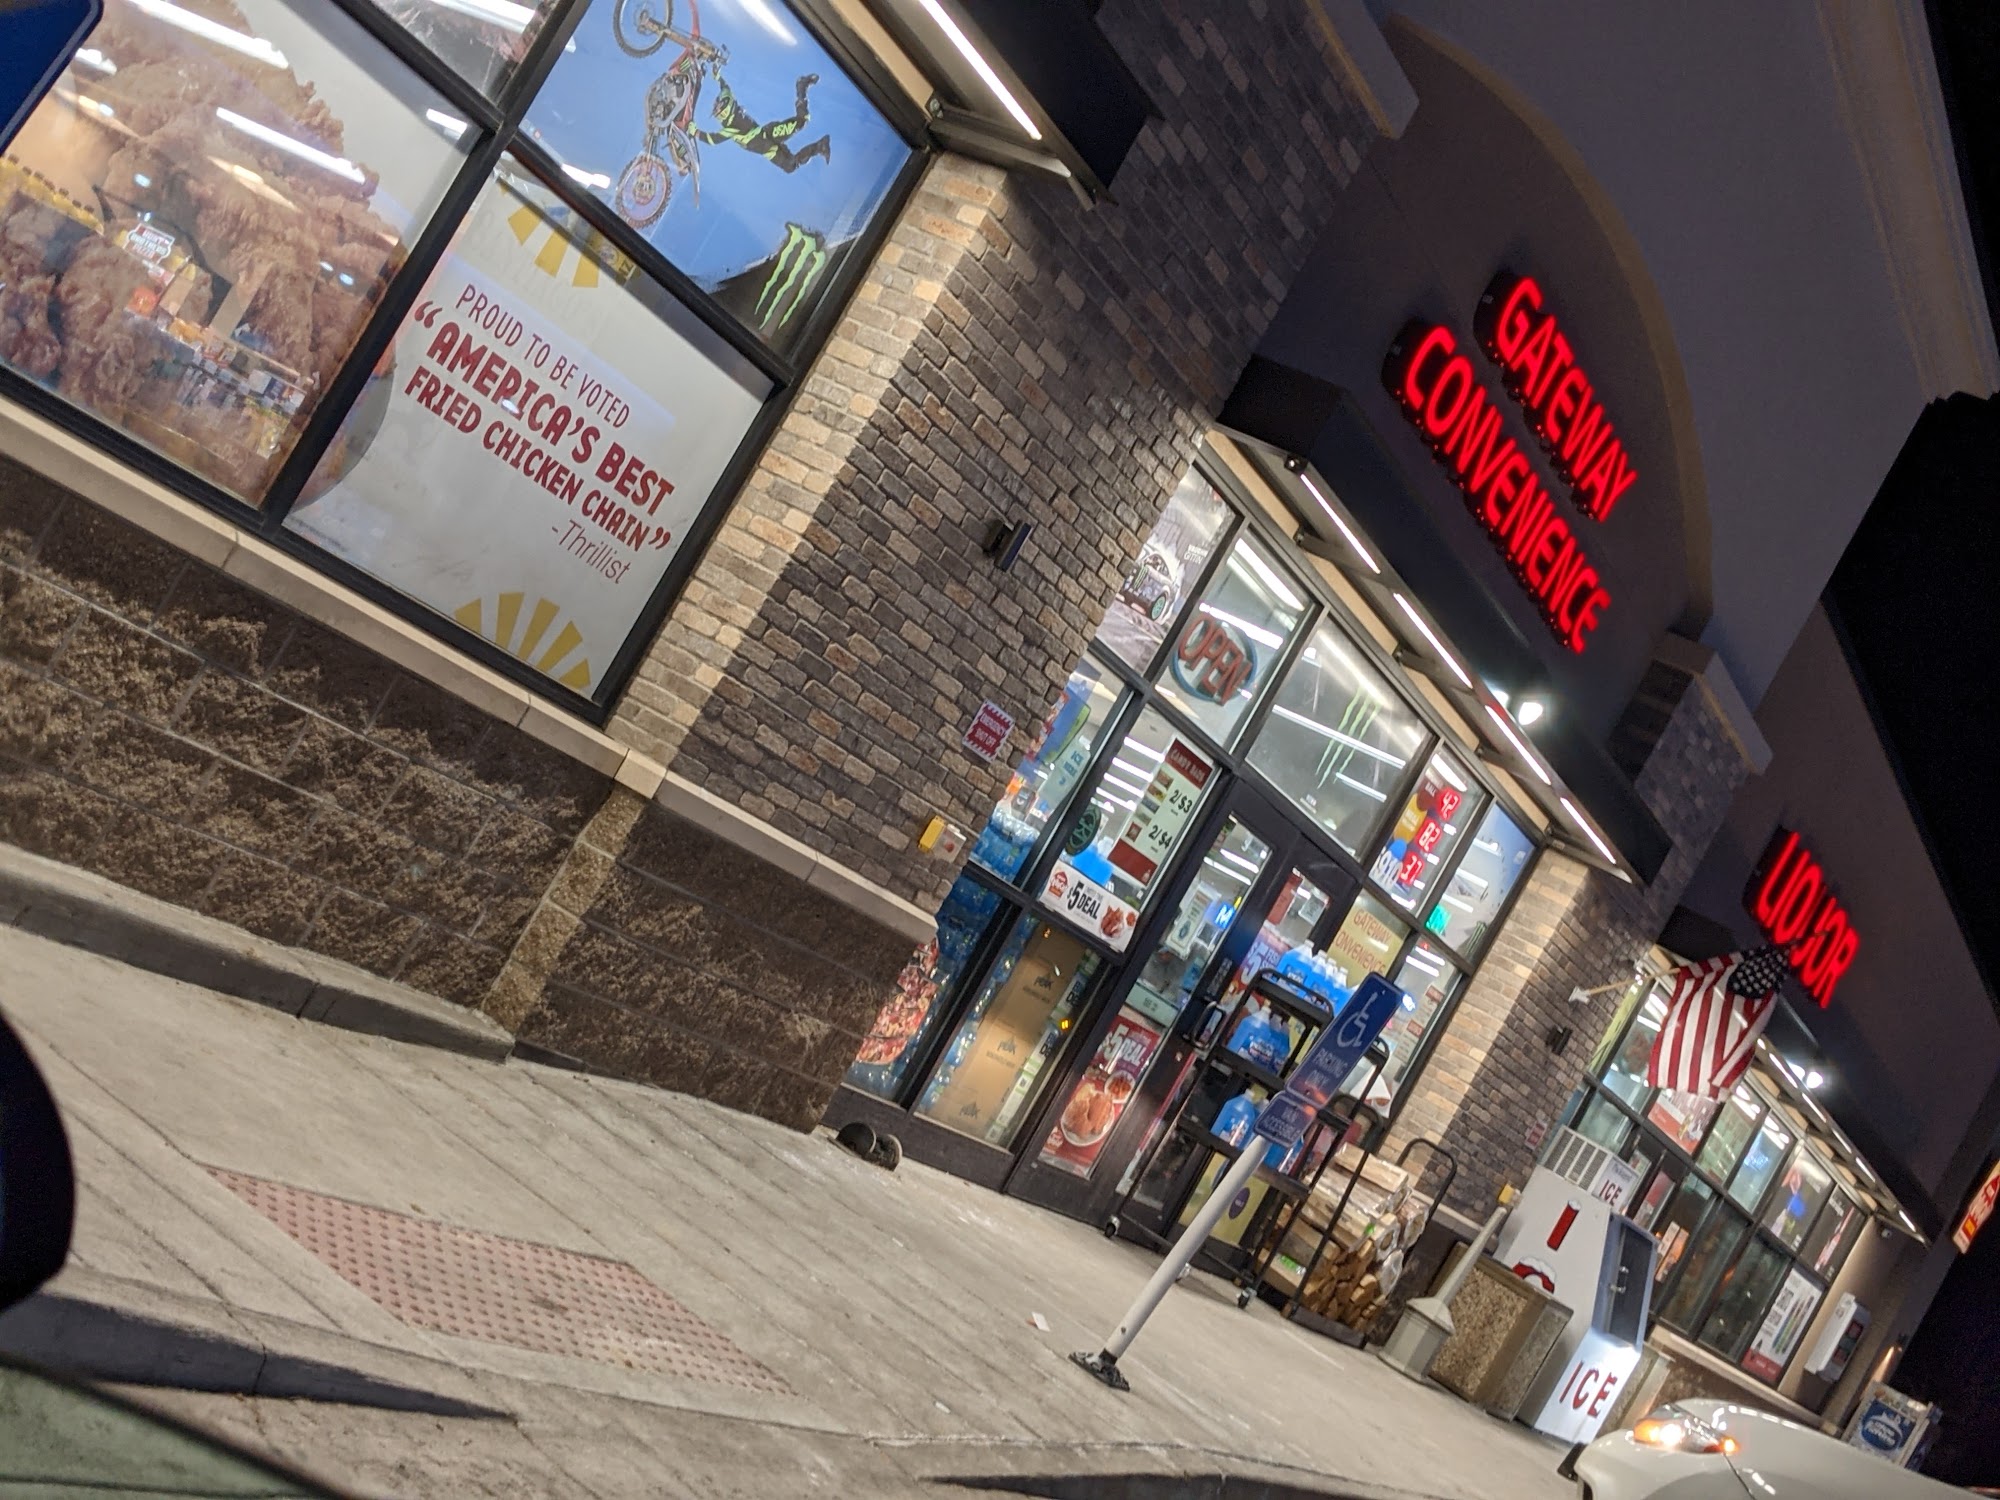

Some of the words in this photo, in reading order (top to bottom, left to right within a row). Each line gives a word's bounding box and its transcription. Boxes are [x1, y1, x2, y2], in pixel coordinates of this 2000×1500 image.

[456, 283, 521, 347] PROUD
[524, 334, 548, 369] TO
[549, 354, 578, 387] BE
[577, 371, 631, 428] VOTED
[1496, 276, 1638, 522] GATEWAY
[404, 366, 483, 433] FRIED
[483, 420, 583, 506] CHICKEN
[595, 443, 674, 516] BEST
[1404, 326, 1612, 655] CONVENIENCE
[1177, 614, 1253, 708] OPEN
[978, 712, 1007, 737] EMERGENCY
[984, 734, 997, 748] OFF
[1169, 747, 1192, 770] CANDY
[1167, 788, 1195, 814] 2/$3
[1440, 792, 1460, 819] 42
[1146, 823, 1173, 850] 2/$4
[1417, 821, 1441, 852] 82
[1399, 854, 1423, 885] 37
[1065, 880, 1085, 911] $5
[1076, 893, 1102, 919] DEAL
[1352, 908, 1392, 944] GATEWAY
[1756, 831, 1861, 1009] LIQUOR
[1097, 1023, 1129, 1061] $5
[1118, 1037, 1147, 1066] DEAL
[1312, 1047, 1348, 1079] PARKING
[1304, 1068, 1330, 1092] ONLY
[1263, 1114, 1301, 1140] ACCESSIBLE
[1280, 1105, 1299, 1124] VAN
[1598, 1178, 1623, 1206] ICE
[1560, 1361, 1619, 1418] ICE
